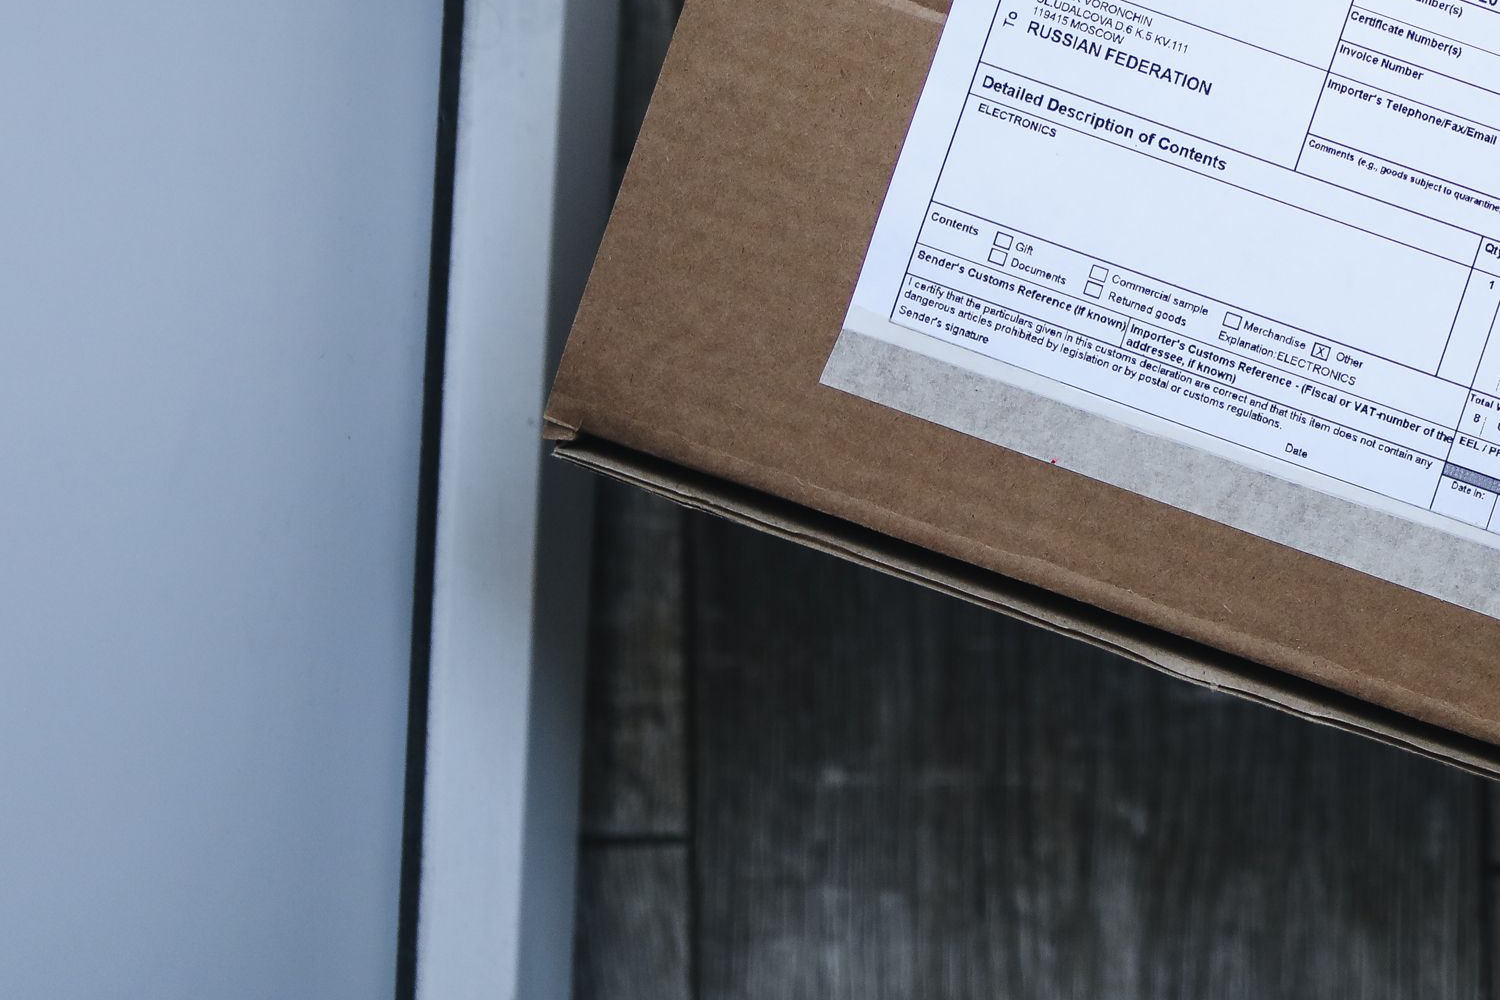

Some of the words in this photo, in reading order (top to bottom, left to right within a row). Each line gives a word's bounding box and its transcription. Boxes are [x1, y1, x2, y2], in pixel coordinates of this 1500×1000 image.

[1002, 10, 1018, 28] To
[1033, 5, 1070, 26] 119415
[1069, 18, 1125, 45] MOSCOW
[1350, 10, 1405, 37] Certificate
[1405, 29, 1463, 59] Number(s)
[1026, 20, 1103, 58] RUSSIAN
[1103, 47, 1213, 96] FEDERATION
[1339, 43, 1380, 65] Invoice
[1380, 57, 1425, 81] Number
[977, 102, 1057, 138] ELECTRONICS
[981, 74, 1045, 108] Detailed
[1046, 97, 1134, 140] Description
[1137, 132, 1157, 146] of
[1157, 136, 1228, 171] Contents
[1326, 78, 1383, 106] Importer's
[1386, 98, 1498, 146] Telephone/Fax/Email
[930, 211, 980, 236] Contents
[1014, 241, 1034, 256] Gift
[1010, 257, 1067, 286] Documents
[1489, 280, 1496, 290] 1
[916, 249, 966, 275] Sender's
[967, 267, 1016, 292] Customs
[1016, 284, 1073, 312] Reference
[1085, 308, 1127, 333] known)
[1111, 274, 1172, 303] Commercial
[1172, 297, 1209, 316] sample
[1107, 290, 1155, 315] Returned
[1154, 309, 1187, 327] goods
[898, 304, 943, 328] Sender's
[944, 322, 990, 345] signature
[1243, 319, 1307, 350] Merchandise
[1335, 351, 1364, 369] Other
[1470, 392, 1495, 409] Total
[1472, 413, 1482, 424] 8
[1284, 442, 1308, 459] Date
[1458, 435, 1481, 452] EEL
[1450, 480, 1472, 495] Date
[1472, 488, 1486, 500] In:
